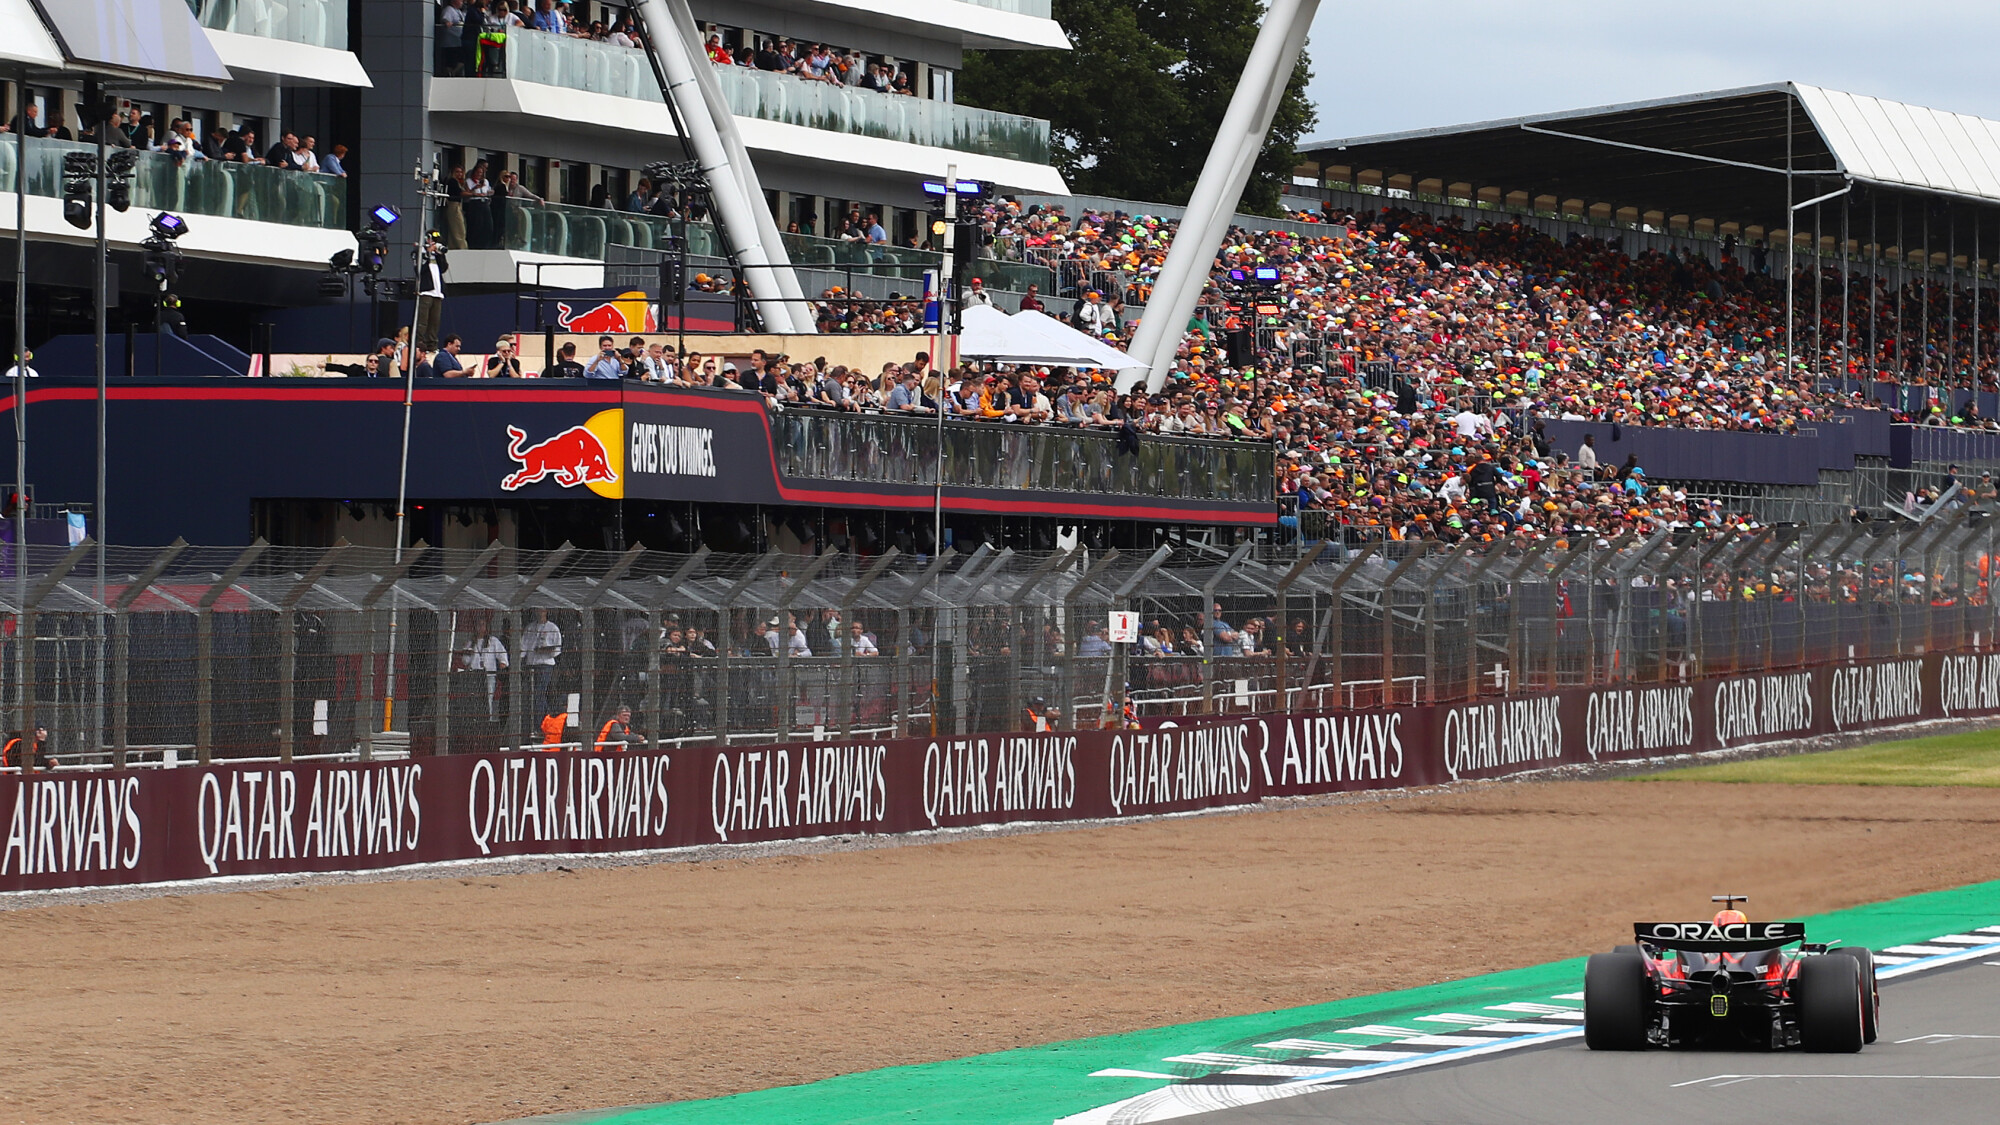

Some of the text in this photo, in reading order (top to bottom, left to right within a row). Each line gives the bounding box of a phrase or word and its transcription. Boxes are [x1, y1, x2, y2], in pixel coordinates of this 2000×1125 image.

[631, 421, 658, 474] GIVES
[658, 424, 678, 475] YOU
[1587, 686, 1694, 761] QATAR AIRWAYS
[1715, 671, 1813, 748] QATAR AIRWAYS
[1832, 659, 1923, 732] QATAR AIRWAYS
[1941, 653, 2000, 718] QATAR AIR
[1110, 731, 1173, 815] QATAR
[1175, 724, 1251, 801] AIRWAYS
[1281, 712, 1403, 786] AIRWAYS
[1444, 695, 1562, 782] QATAR AIRWAYS
[198, 763, 422, 875] QATAR AIRWAYS
[469, 753, 670, 855] QATAR AIRWAYS
[712, 745, 886, 842] QATAR AIRWAYS
[924, 736, 1076, 827] QATAR AIRWAYS
[1, 776, 142, 876] AIRWAYS
[1652, 924, 1786, 940] ORACLE
